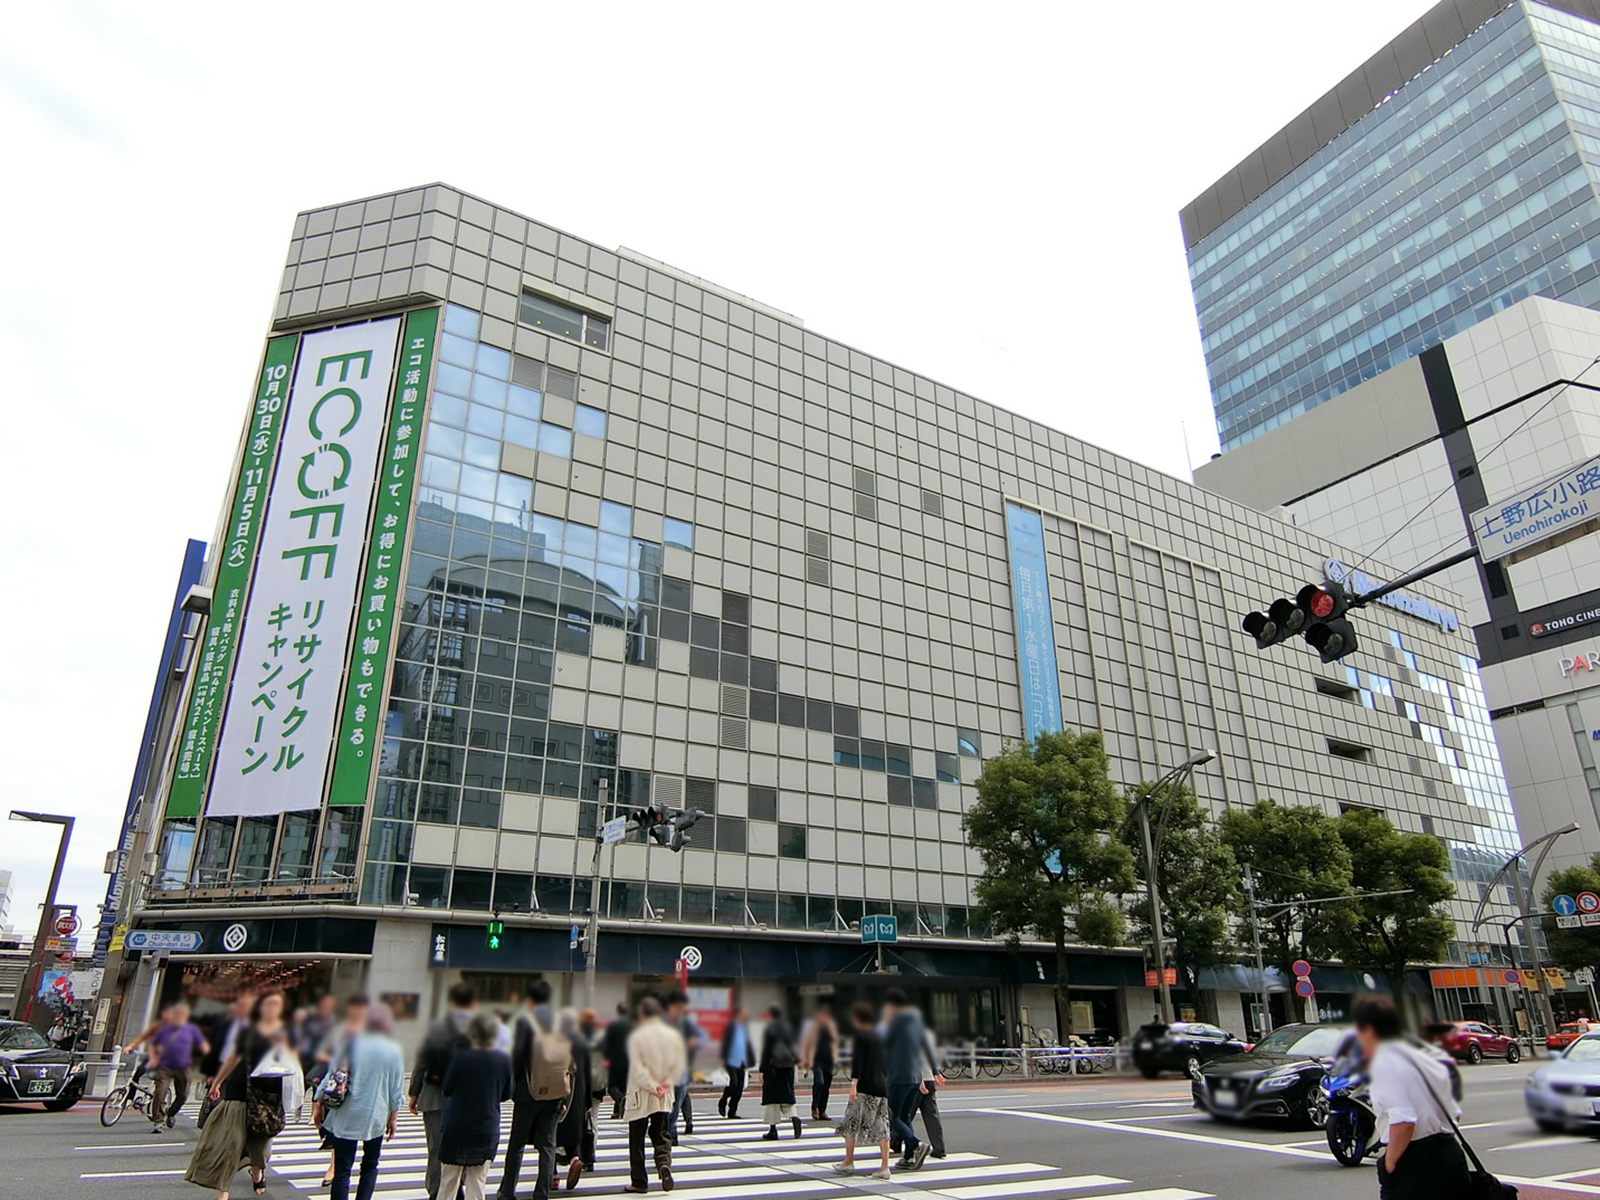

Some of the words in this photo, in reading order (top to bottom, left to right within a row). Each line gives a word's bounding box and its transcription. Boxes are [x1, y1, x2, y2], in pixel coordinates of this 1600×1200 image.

[1481, 465, 1600, 539] 上野広小路
[1503, 499, 1589, 545] Uenohirokoji
[349, 337, 426, 758] エコ活動に参加して、お得にお買い物もできる。
[1544, 616, 1575, 631] TOHO
[240, 602, 293, 776] キャンペーン
[271, 599, 326, 773] リサイクル
[151, 933, 191, 943] 中央通り
[180, 941, 191, 949] Ave
